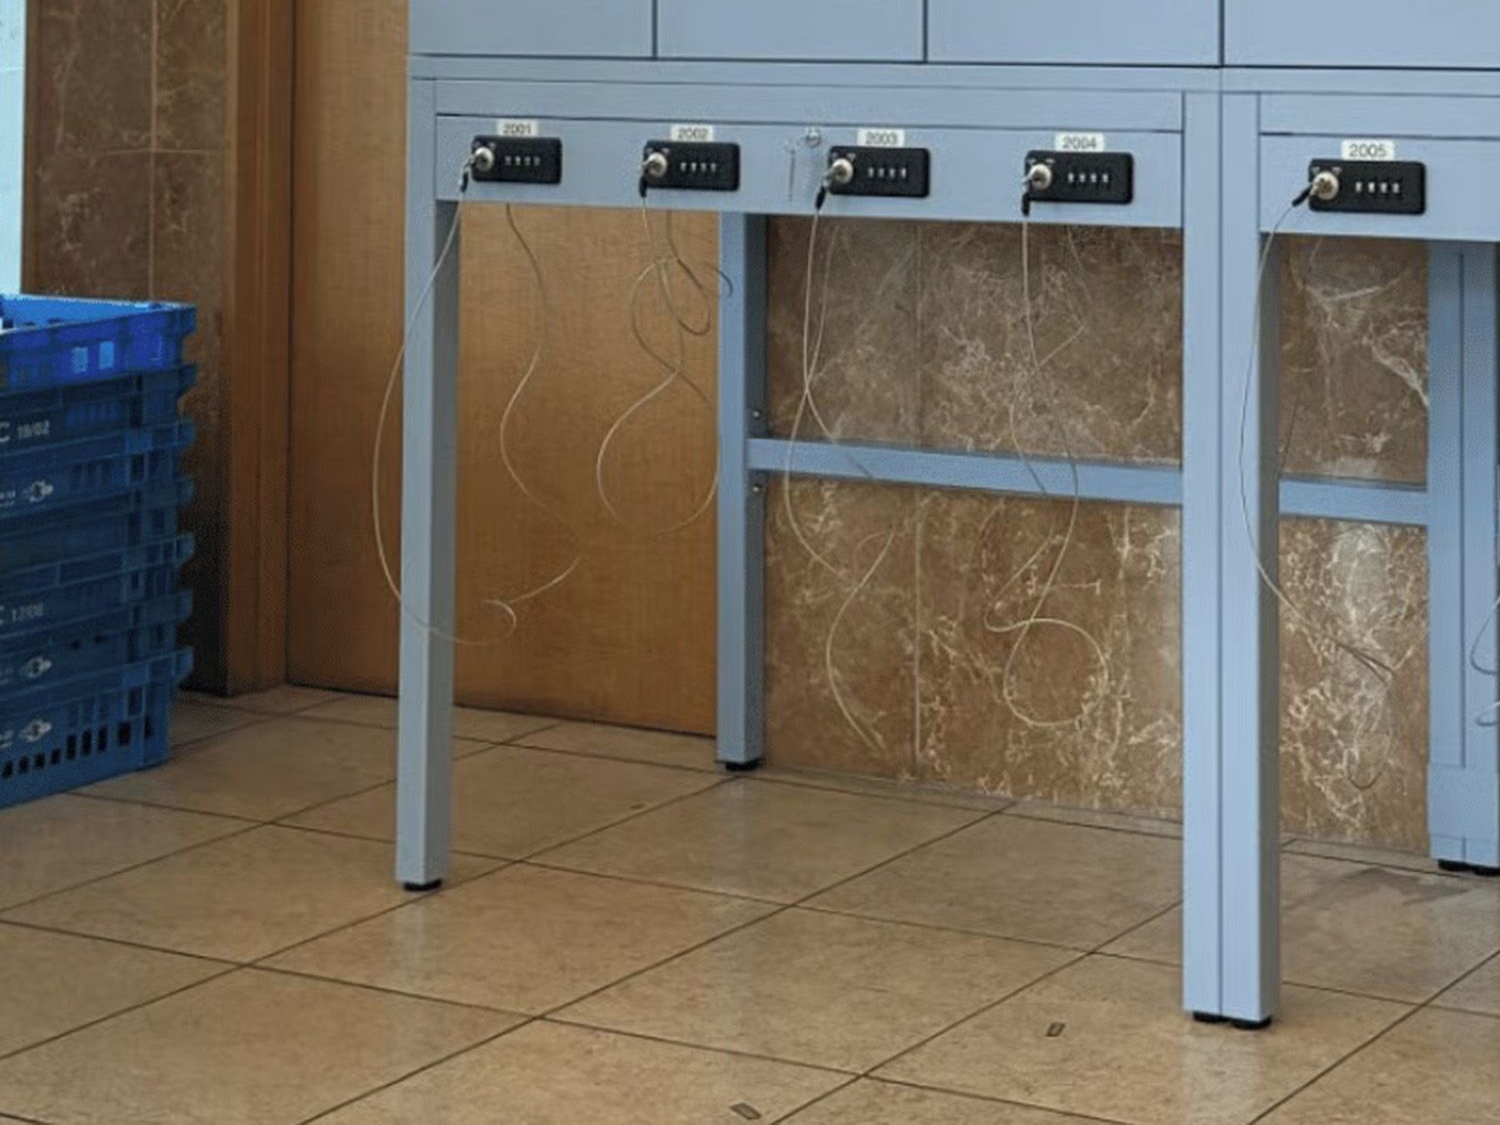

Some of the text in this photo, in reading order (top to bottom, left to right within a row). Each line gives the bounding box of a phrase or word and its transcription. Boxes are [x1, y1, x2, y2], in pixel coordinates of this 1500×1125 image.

[503, 123, 533, 135] 2001
[677, 127, 708, 139] 2002
[865, 132, 898, 145] 2003
[1062, 136, 1097, 149] 2004
[1349, 143, 1387, 158] 2005
